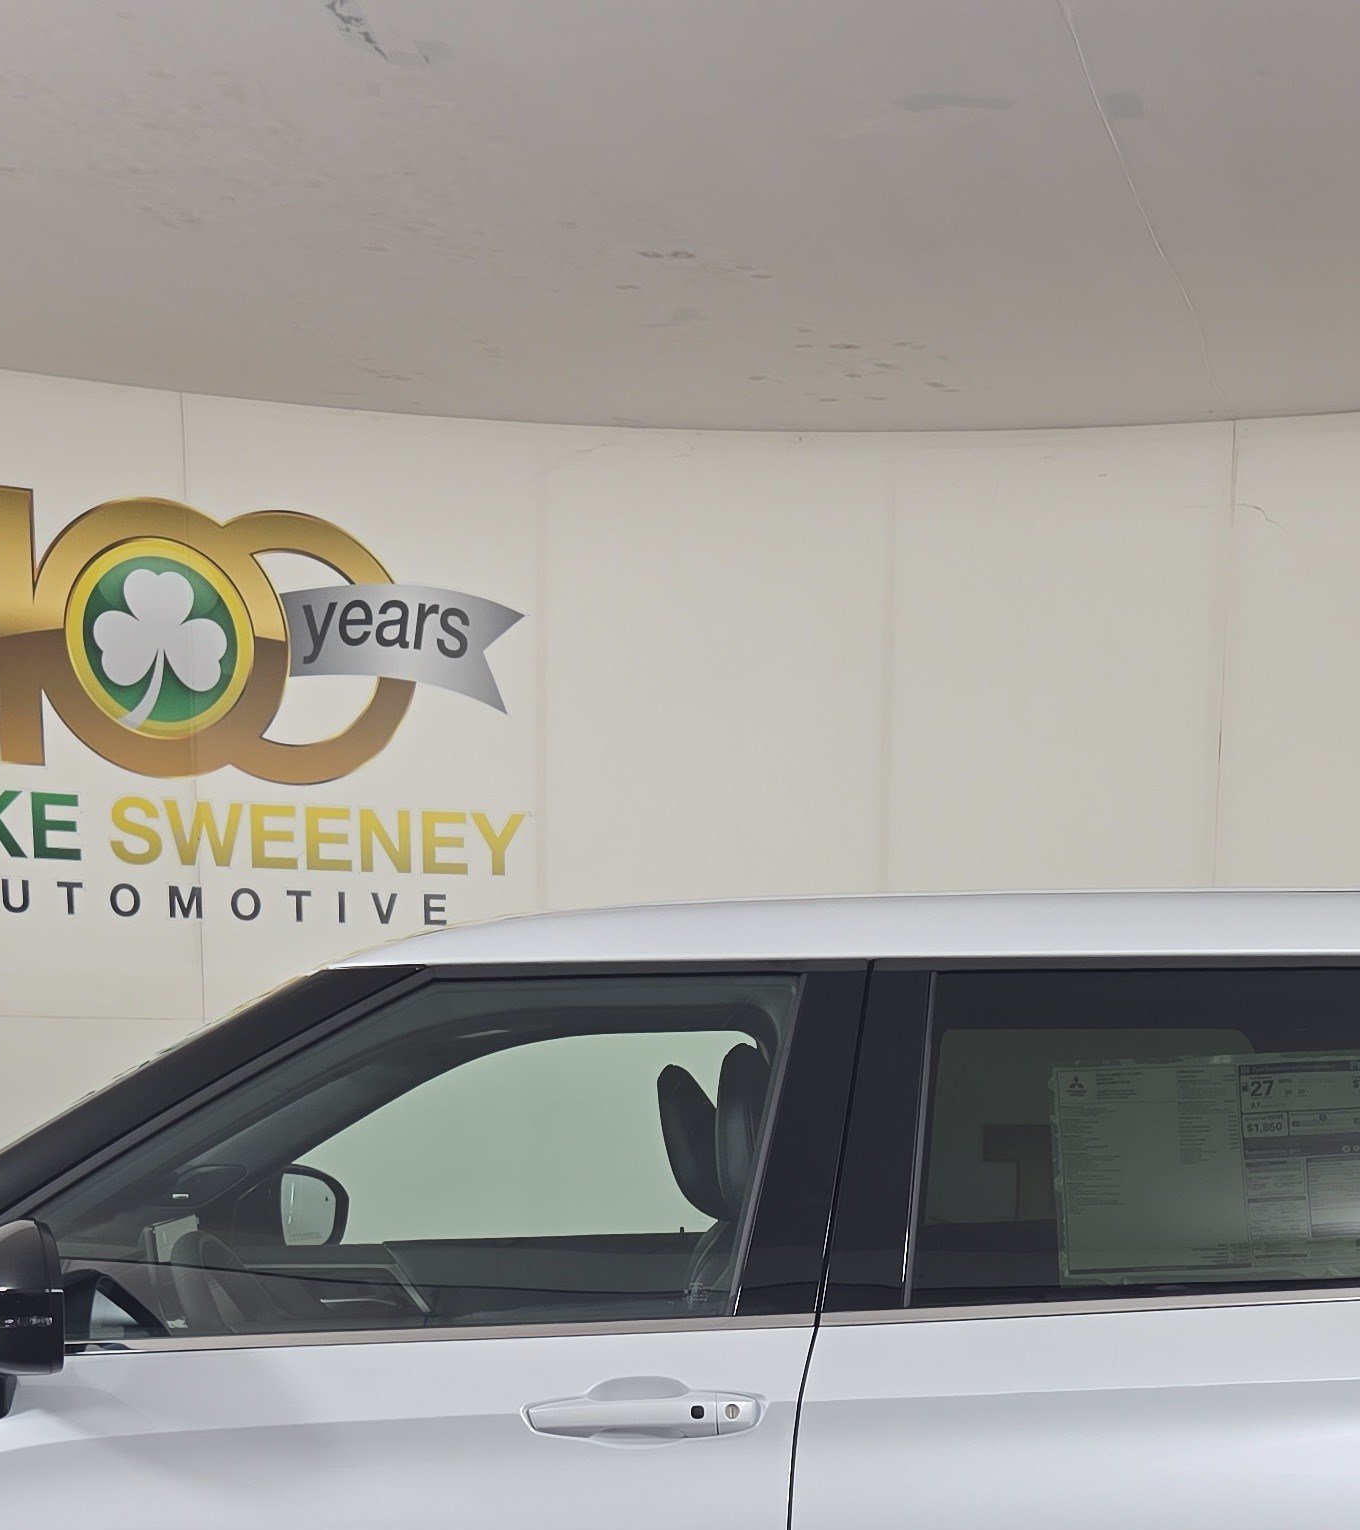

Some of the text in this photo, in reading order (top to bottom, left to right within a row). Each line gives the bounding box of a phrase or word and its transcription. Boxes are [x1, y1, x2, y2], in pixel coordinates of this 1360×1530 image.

[302, 598, 471, 665] years
[109, 796, 526, 876] SWEENEY
[1250, 1080, 1274, 1097] 27
